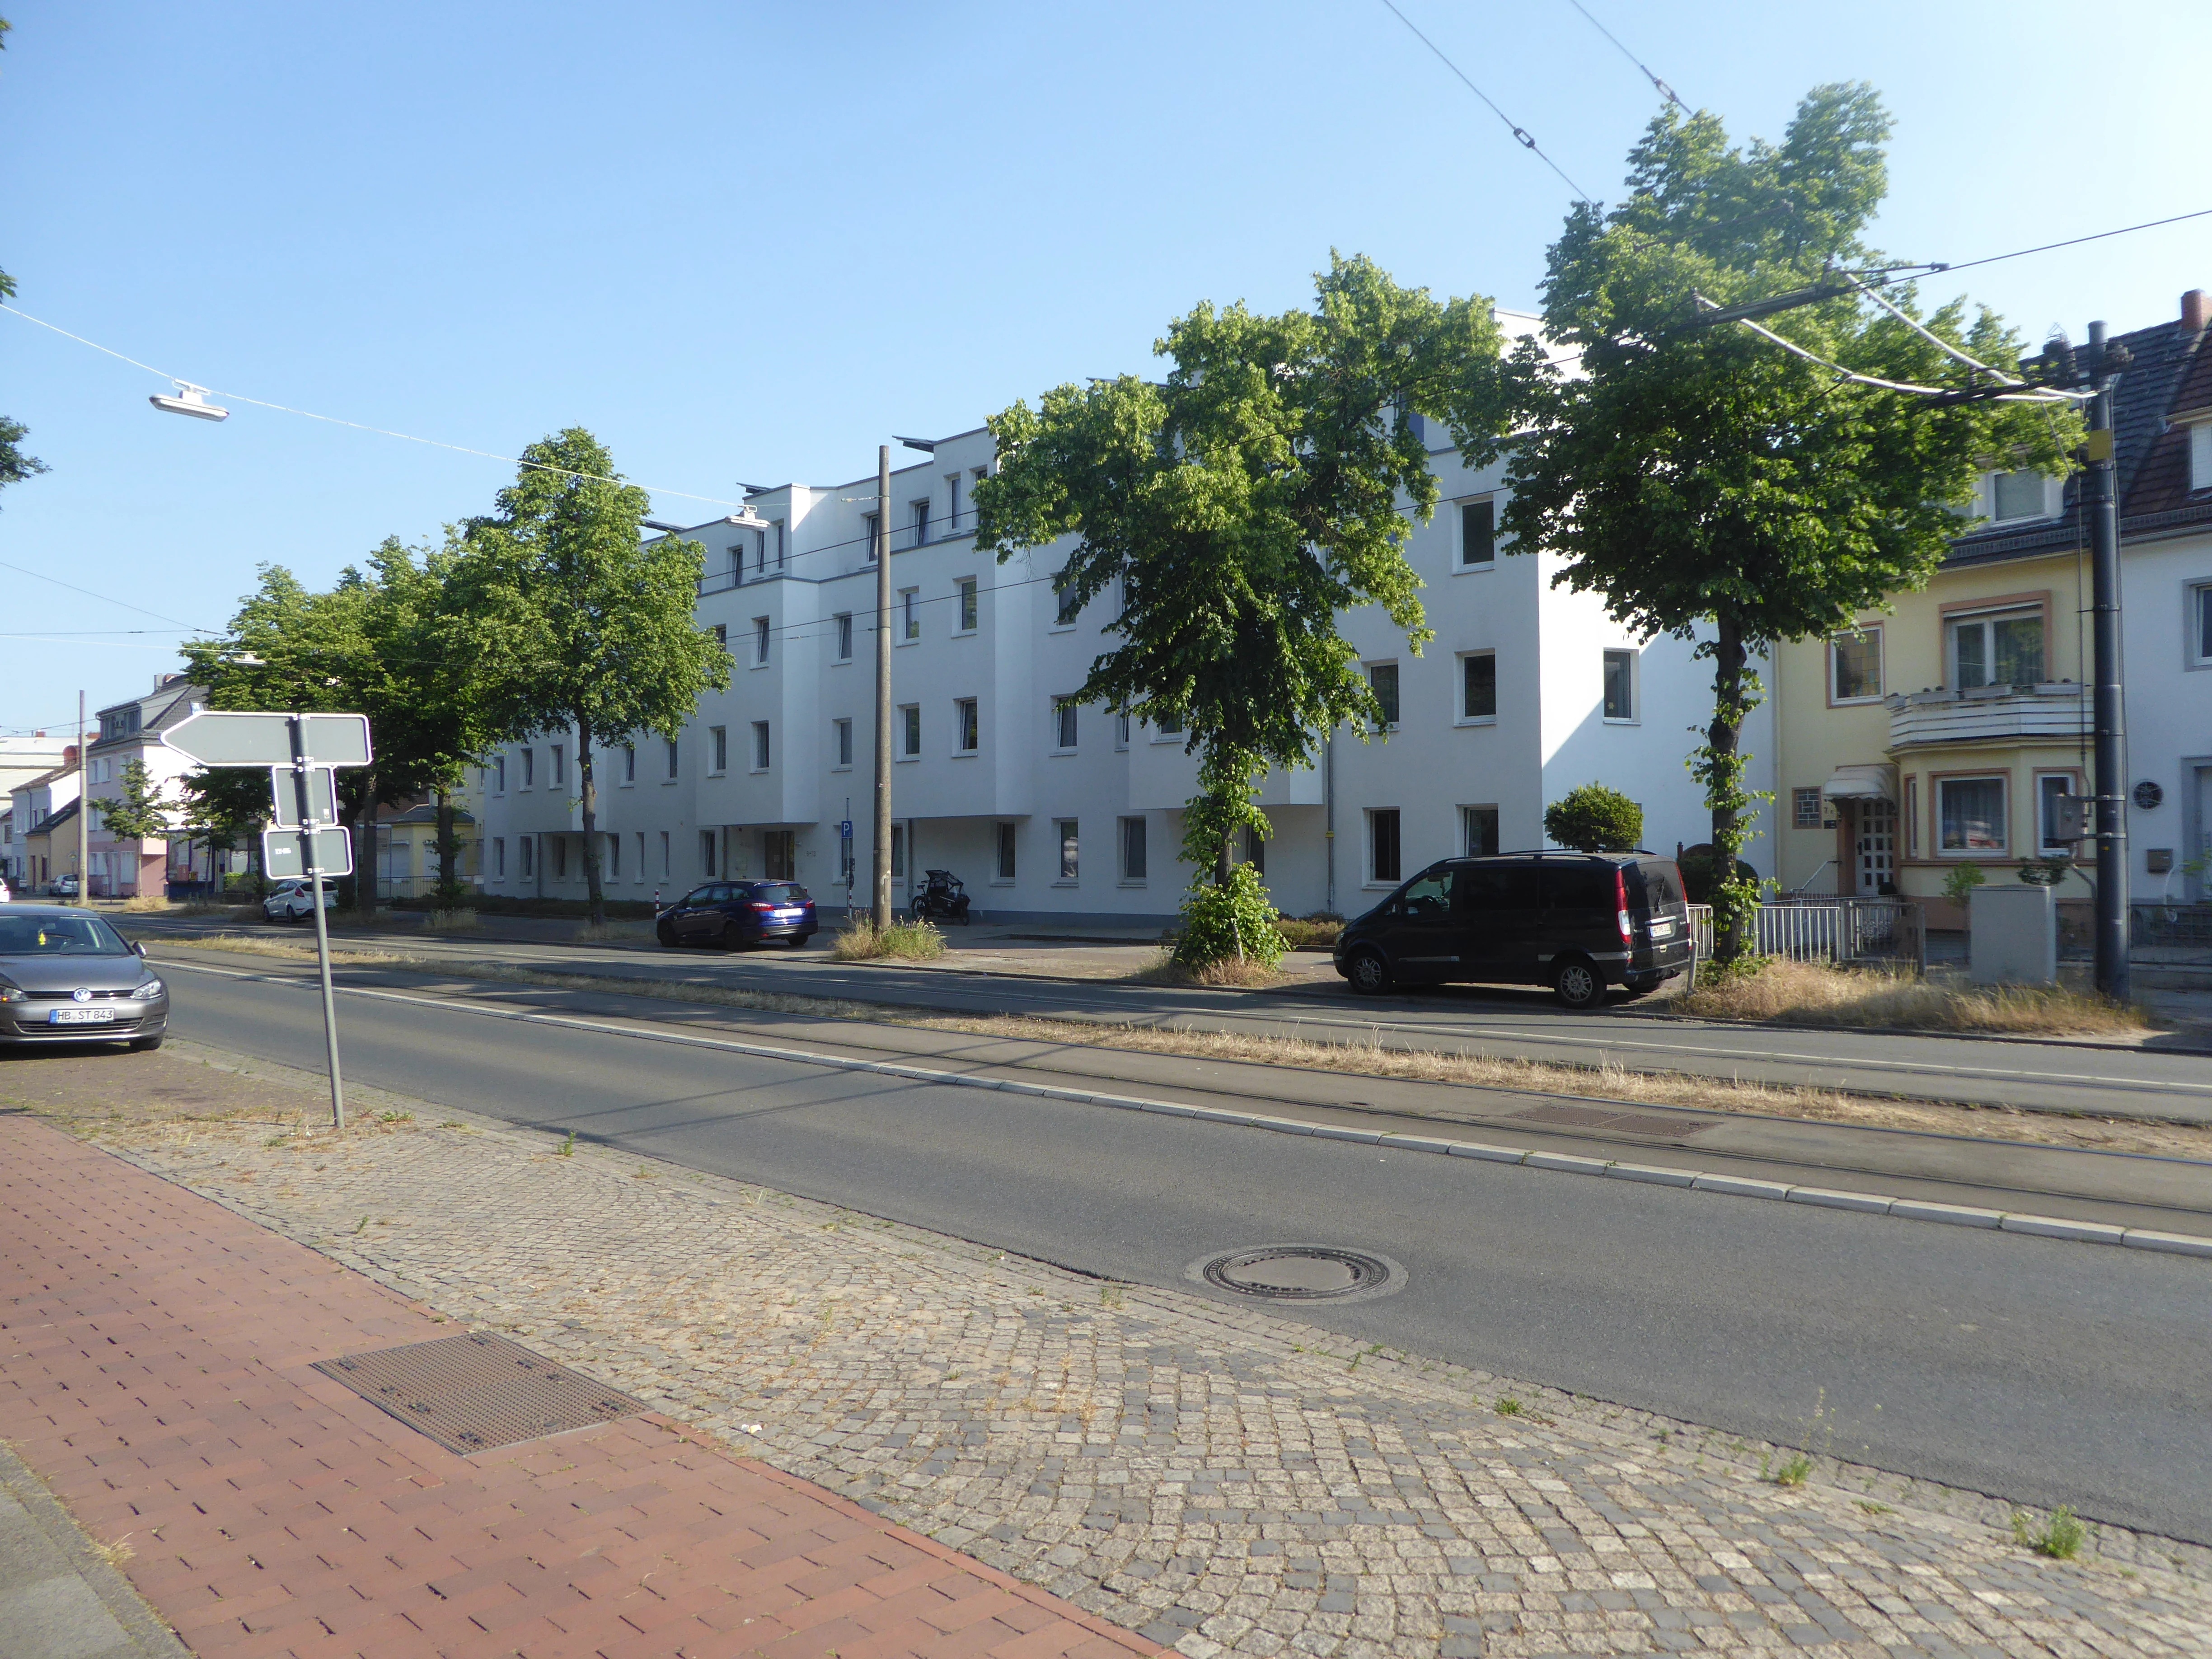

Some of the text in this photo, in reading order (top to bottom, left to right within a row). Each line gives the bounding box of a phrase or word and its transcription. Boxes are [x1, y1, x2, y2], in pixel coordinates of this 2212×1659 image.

[844, 823, 850, 836] P
[58, 1010, 112, 1020] HB ST 843
